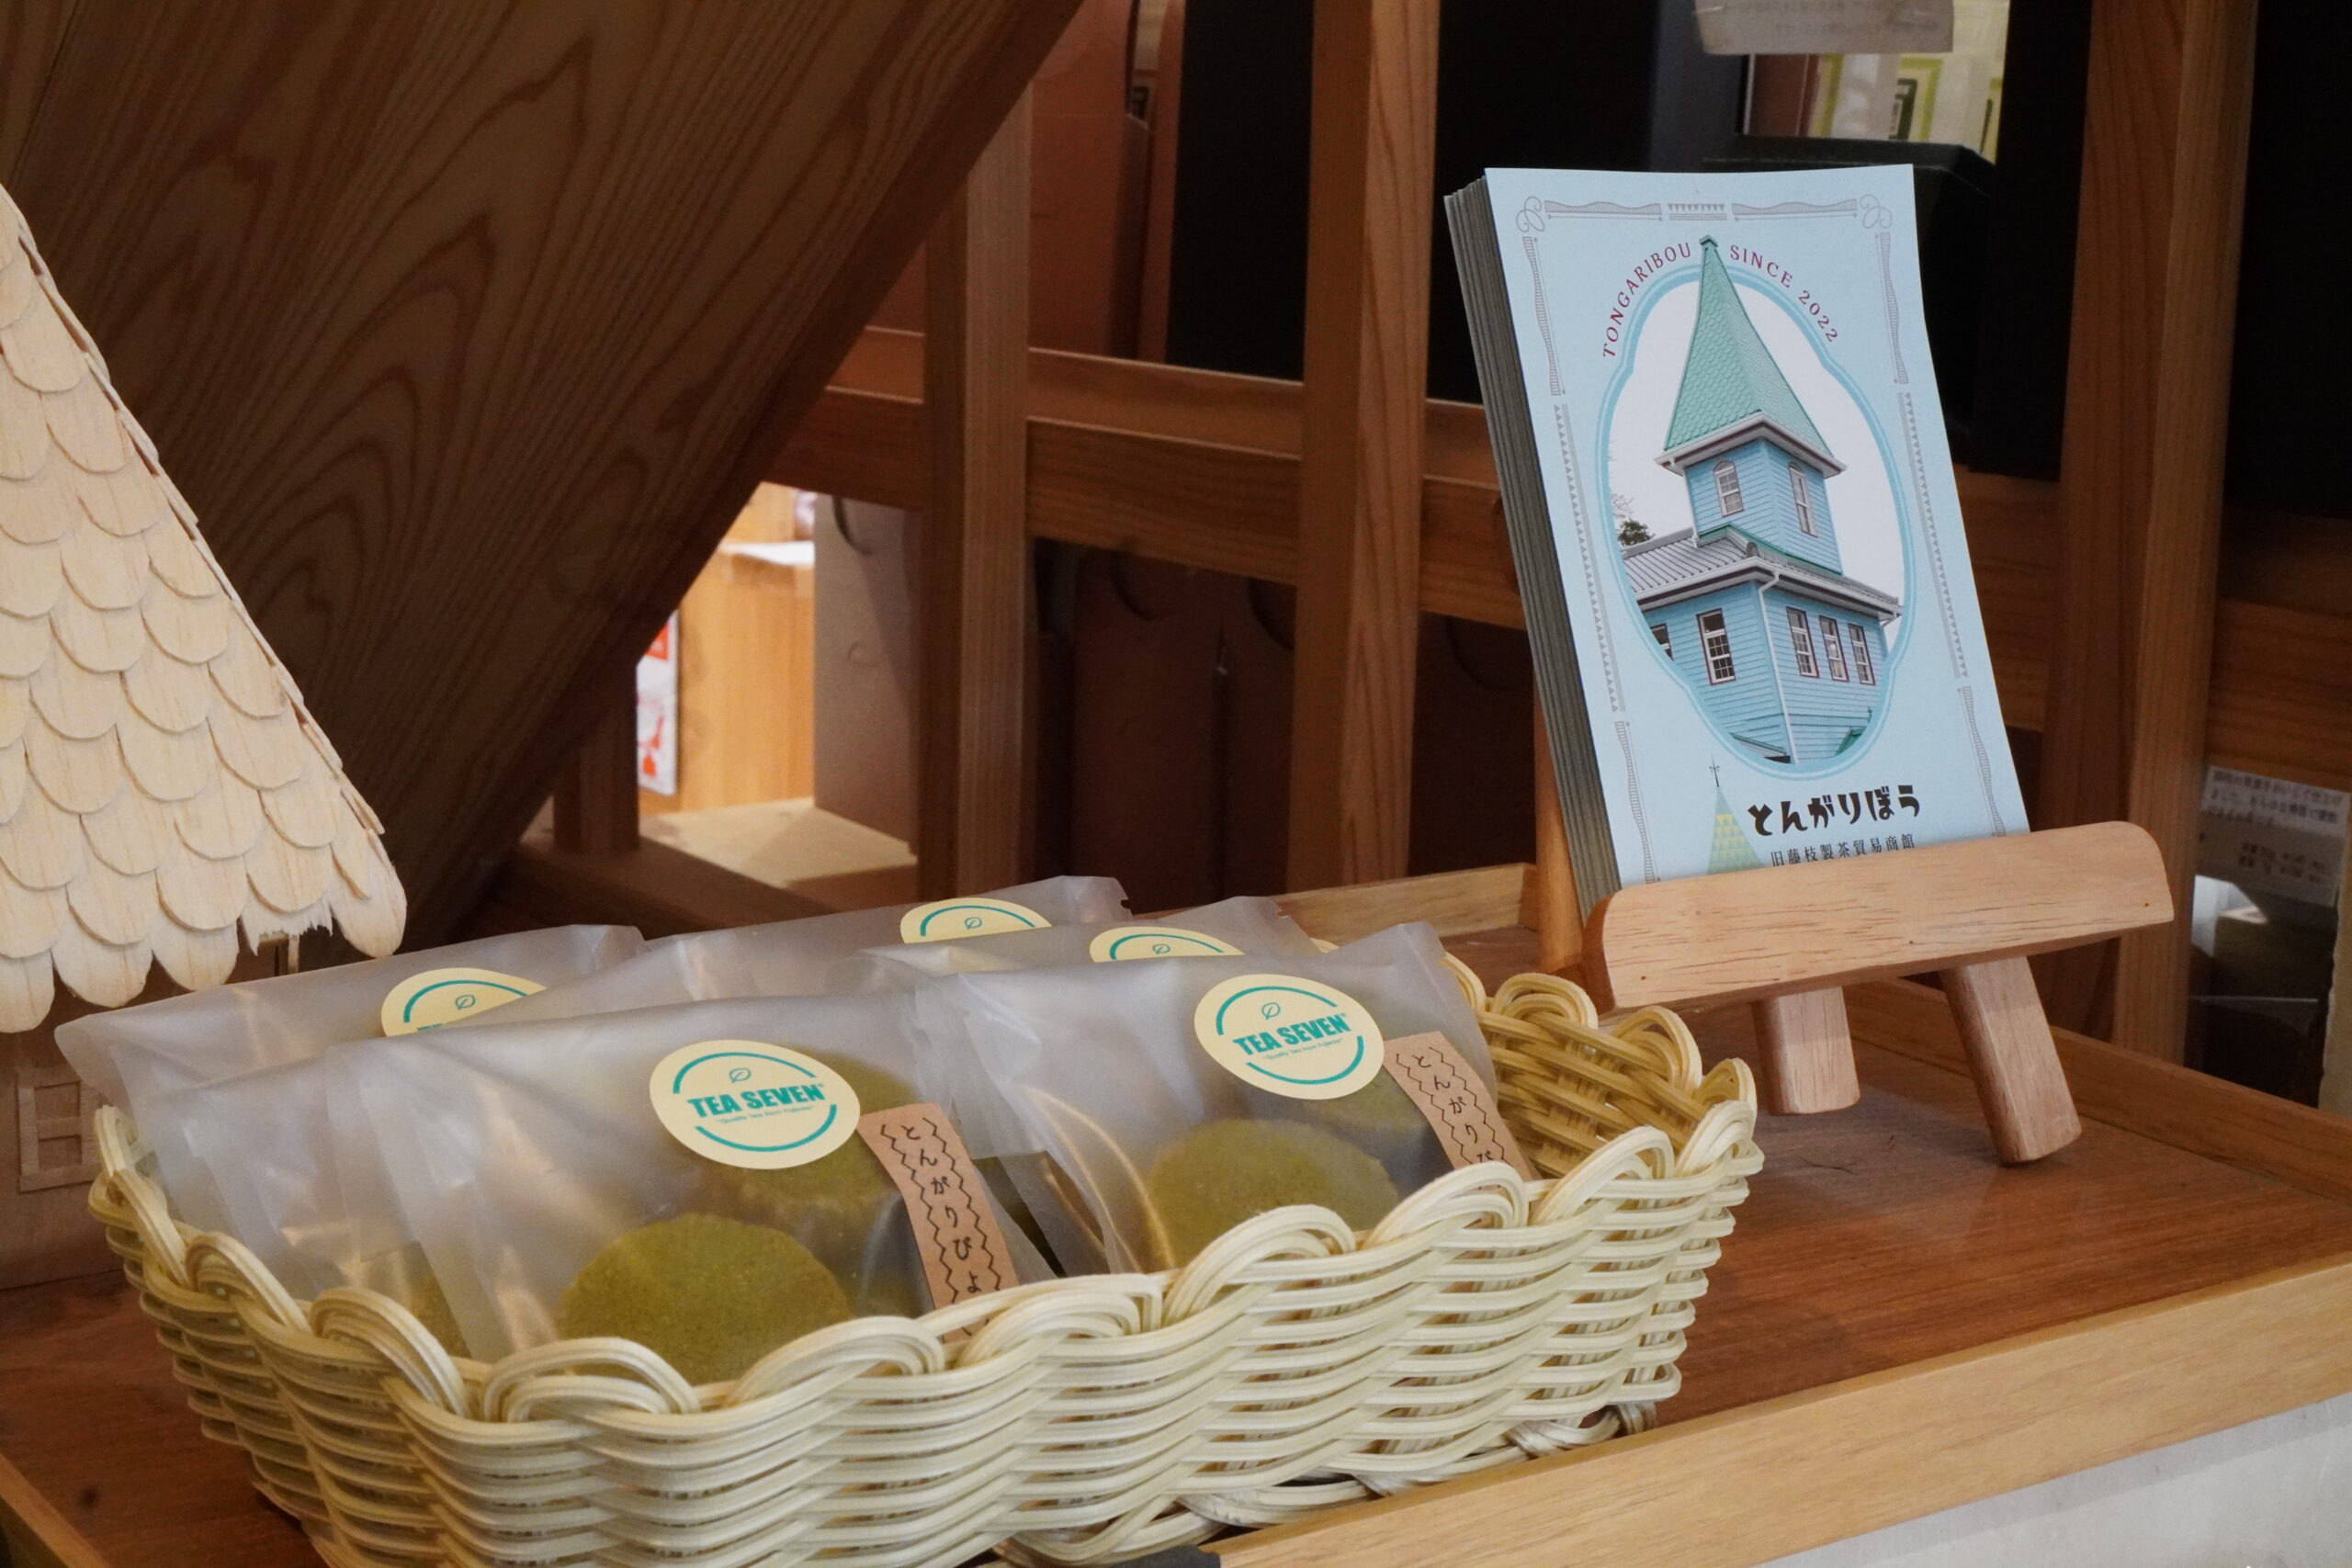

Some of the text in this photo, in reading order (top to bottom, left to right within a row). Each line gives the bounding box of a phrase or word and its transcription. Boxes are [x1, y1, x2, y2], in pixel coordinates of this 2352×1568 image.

[1602, 243, 1838, 358] TONGARIBOU SINCE 2022
[1747, 784, 1920, 837] とんがりぼう
[1770, 833, 1915, 867] 旧藤枝製茶貿易商館
[1232, 1032, 1282, 1055] TEA
[1277, 1014, 1351, 1045] SEVEN
[687, 1094, 741, 1117] TEA
[741, 1084, 825, 1109] SEVEN
